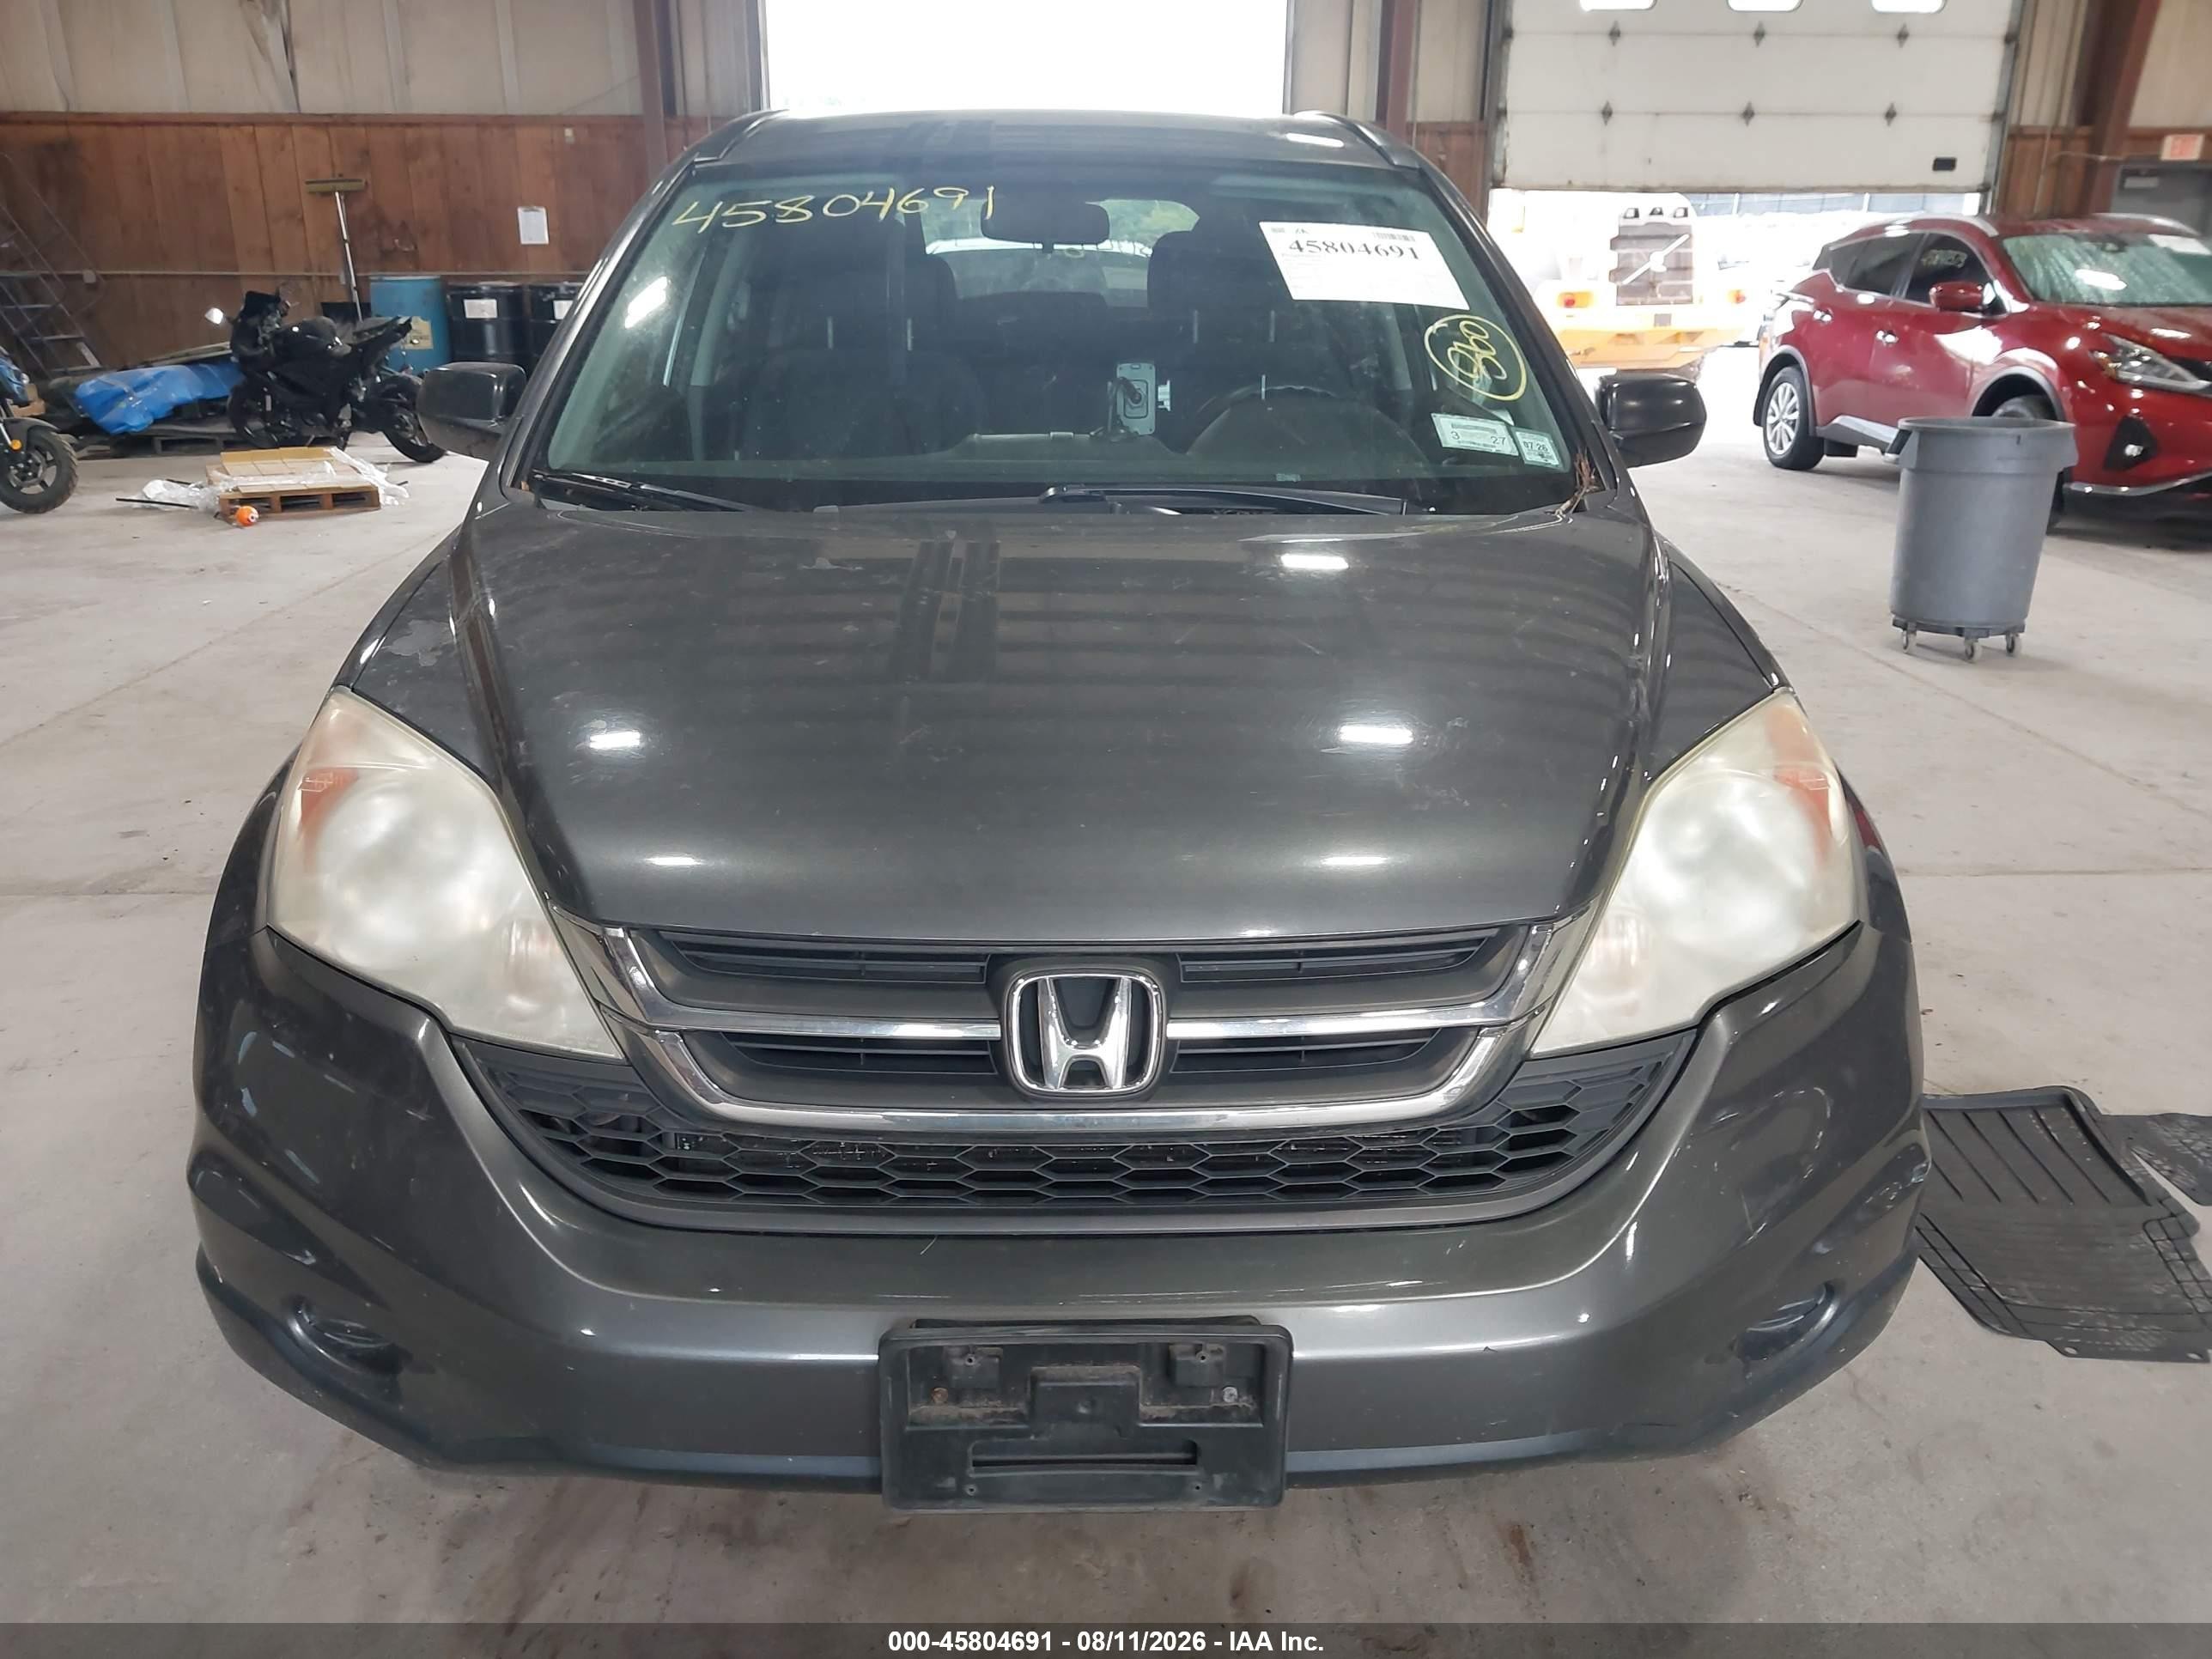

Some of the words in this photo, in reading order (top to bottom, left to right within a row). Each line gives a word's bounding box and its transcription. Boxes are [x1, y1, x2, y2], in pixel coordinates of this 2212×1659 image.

[672, 185, 995, 234] 45804691
[1288, 240, 1419, 259] 45804691
[1490, 435, 1506, 446] 27
